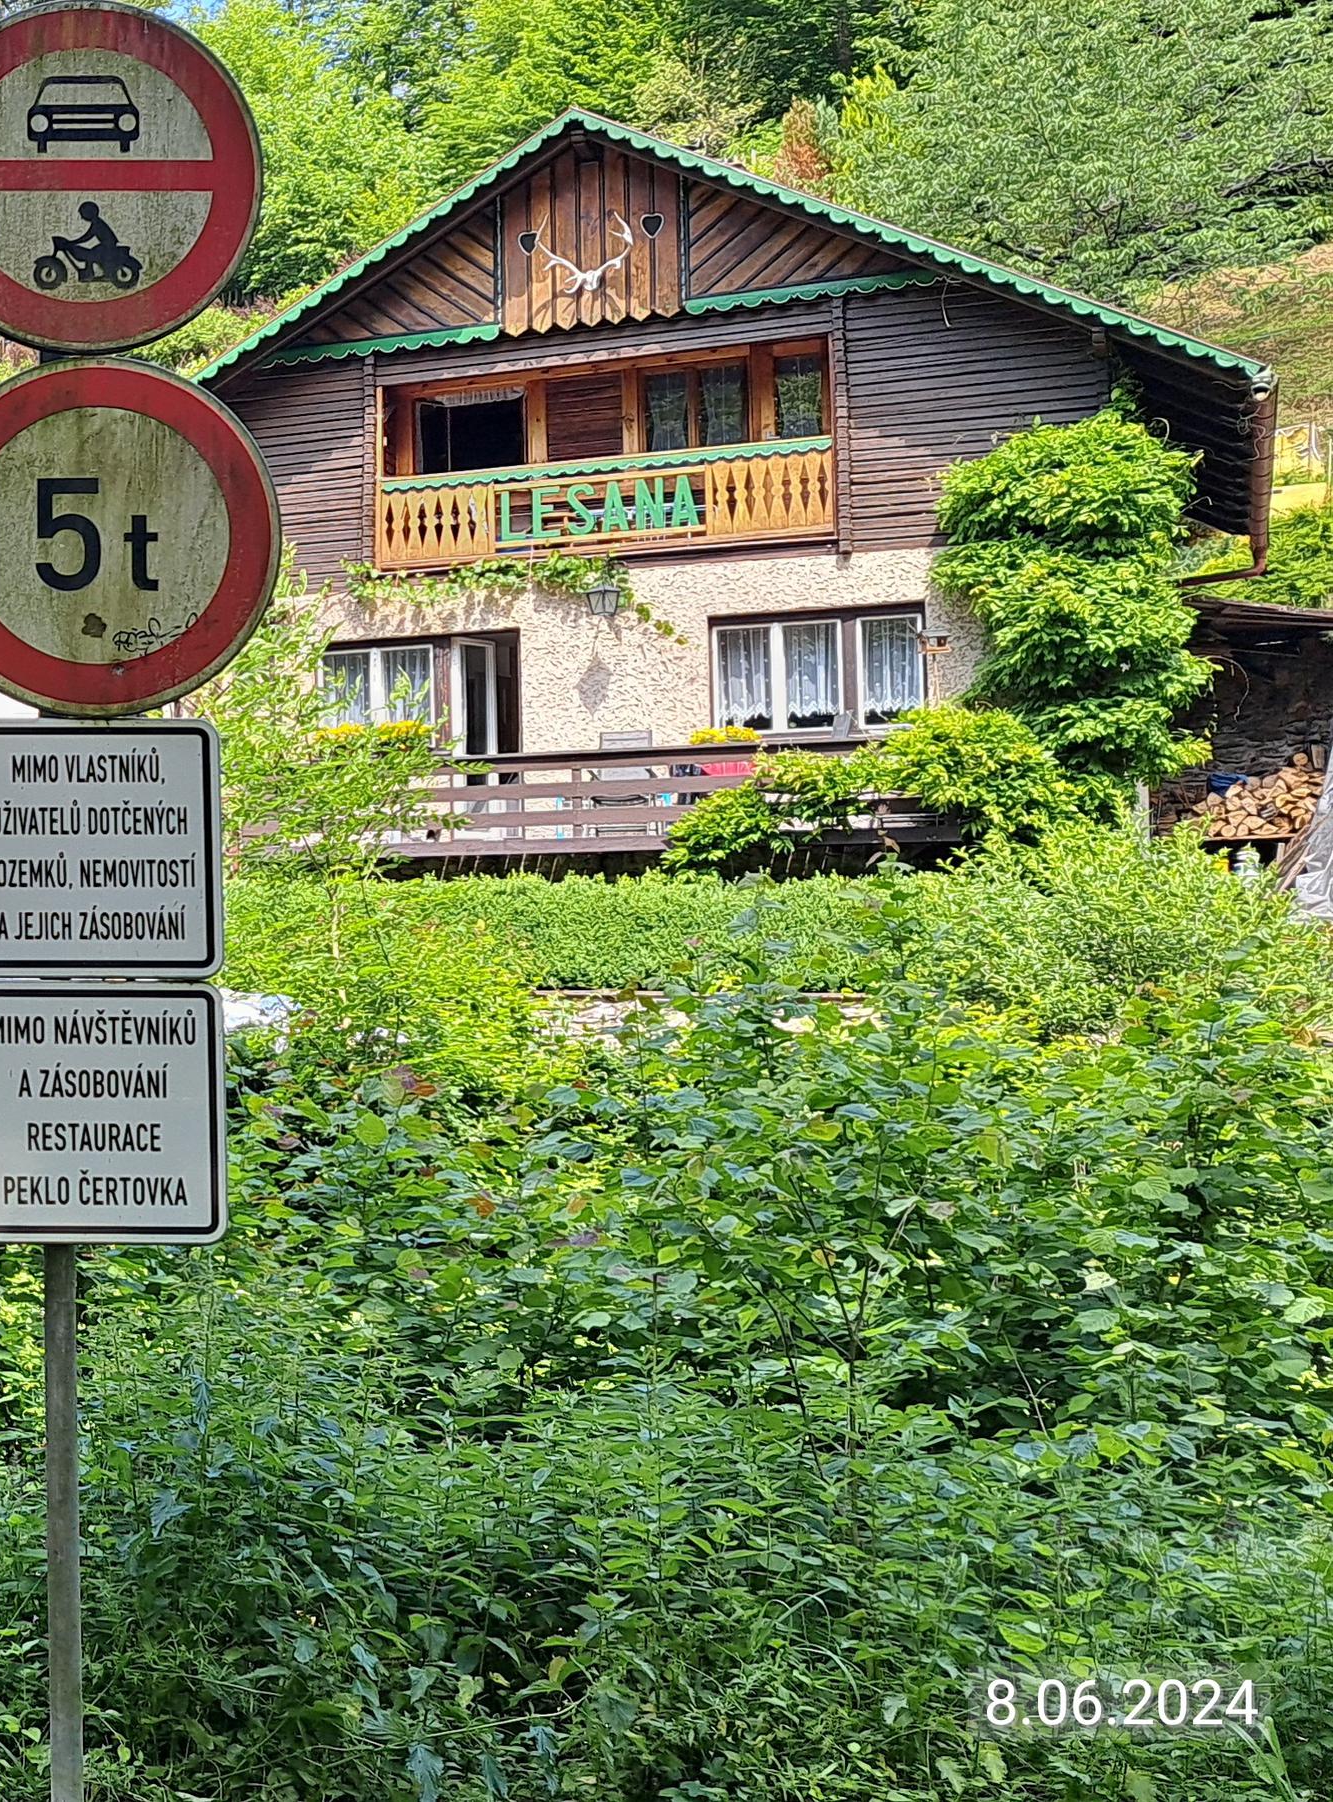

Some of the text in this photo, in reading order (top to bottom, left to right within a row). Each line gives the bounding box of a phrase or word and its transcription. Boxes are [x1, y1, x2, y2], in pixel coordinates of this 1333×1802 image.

[501, 474, 700, 541] LESANA
[35, 477, 159, 592] 5 t
[11, 748, 166, 786] MIMO VLASTNÍKŮ,
[88, 800, 188, 835] DOTČENÝCH
[79, 853, 196, 888] NEMOVITOSTÍ
[14, 912, 72, 941] JEJICH
[78, 903, 186, 941] ZÁSOBOVÁNÍ
[53, 1008, 196, 1045] NÁVŠTĚVNÍKŮ
[18, 1062, 169, 1099] A ZÁSOBOVÁNÍ
[27, 1123, 161, 1152] RESTAURACE
[3, 1170, 187, 1206] PEKLO ČERTOVKA
